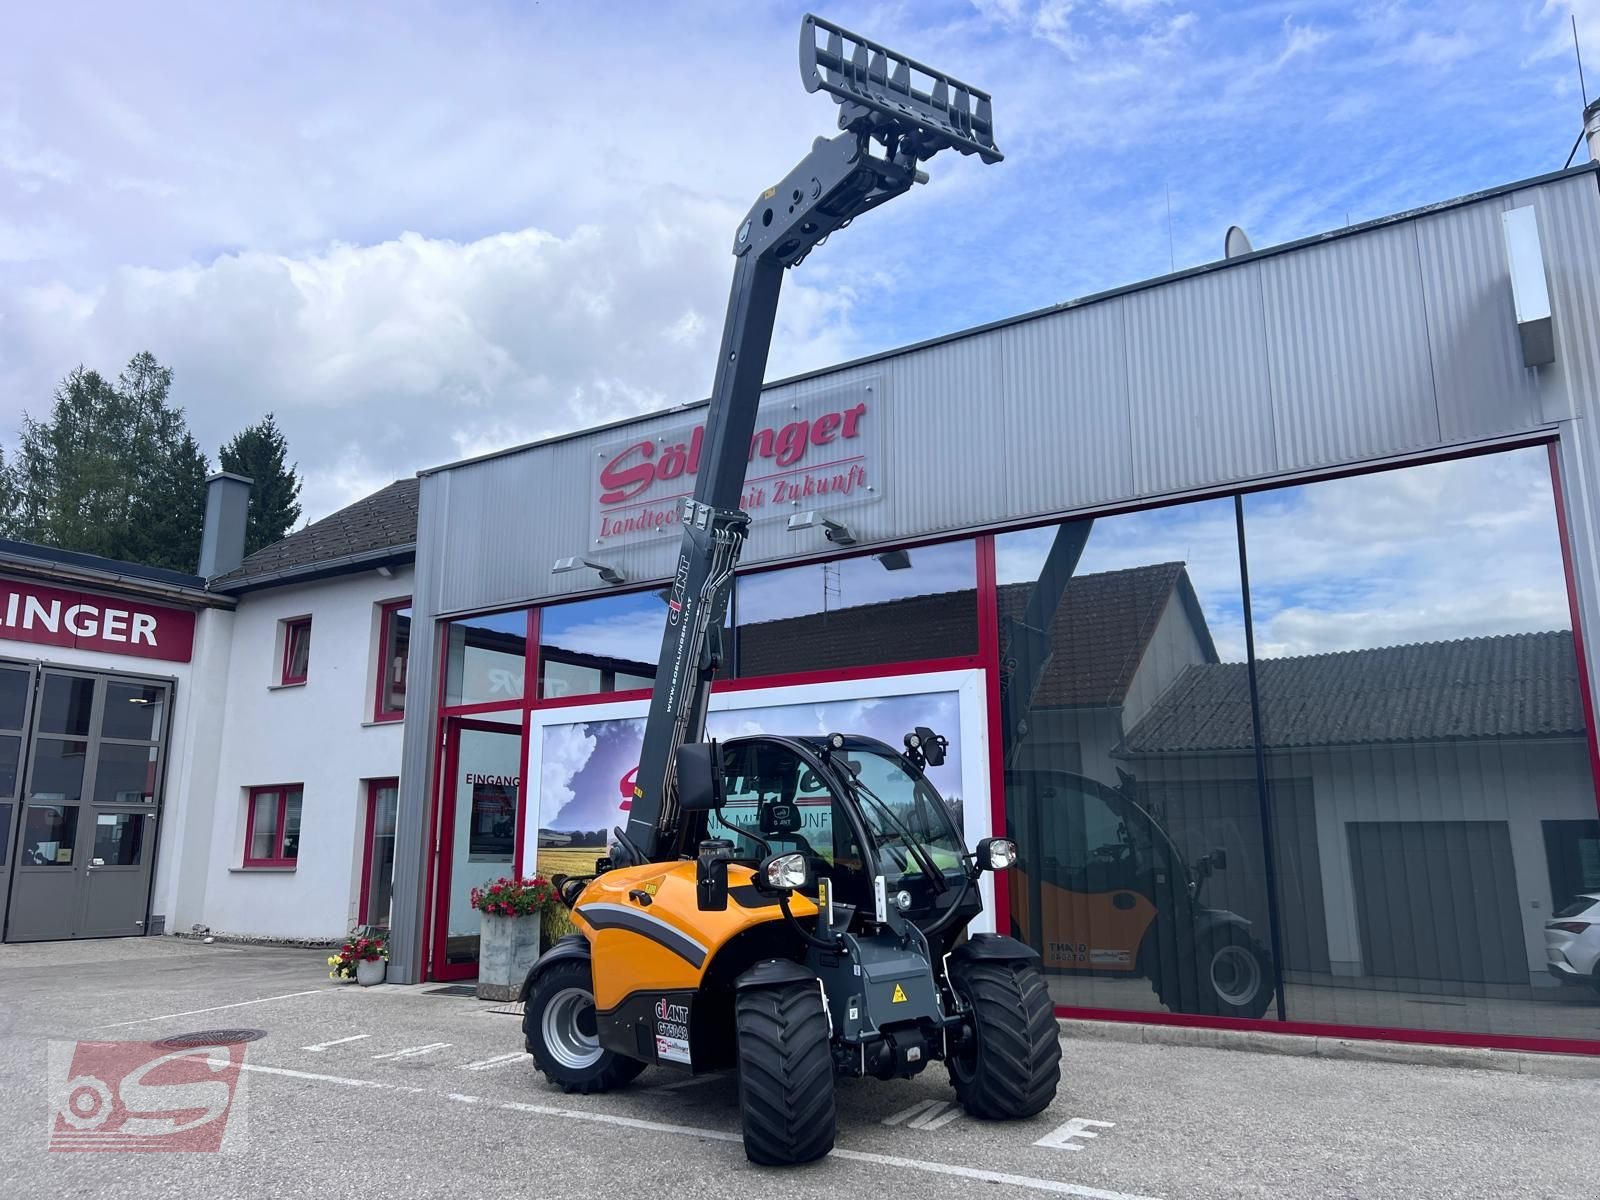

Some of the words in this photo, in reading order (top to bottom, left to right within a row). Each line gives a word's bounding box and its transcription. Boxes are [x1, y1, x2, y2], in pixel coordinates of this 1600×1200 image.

[599, 402, 866, 504] Sölnger
[600, 506, 683, 537] Landtec
[772, 464, 865, 504] Zukunft
[0, 592, 158, 647] INGER
[669, 555, 690, 626] GIANT
[466, 773, 520, 788] EINGANG
[655, 998, 688, 1024] GIANT
